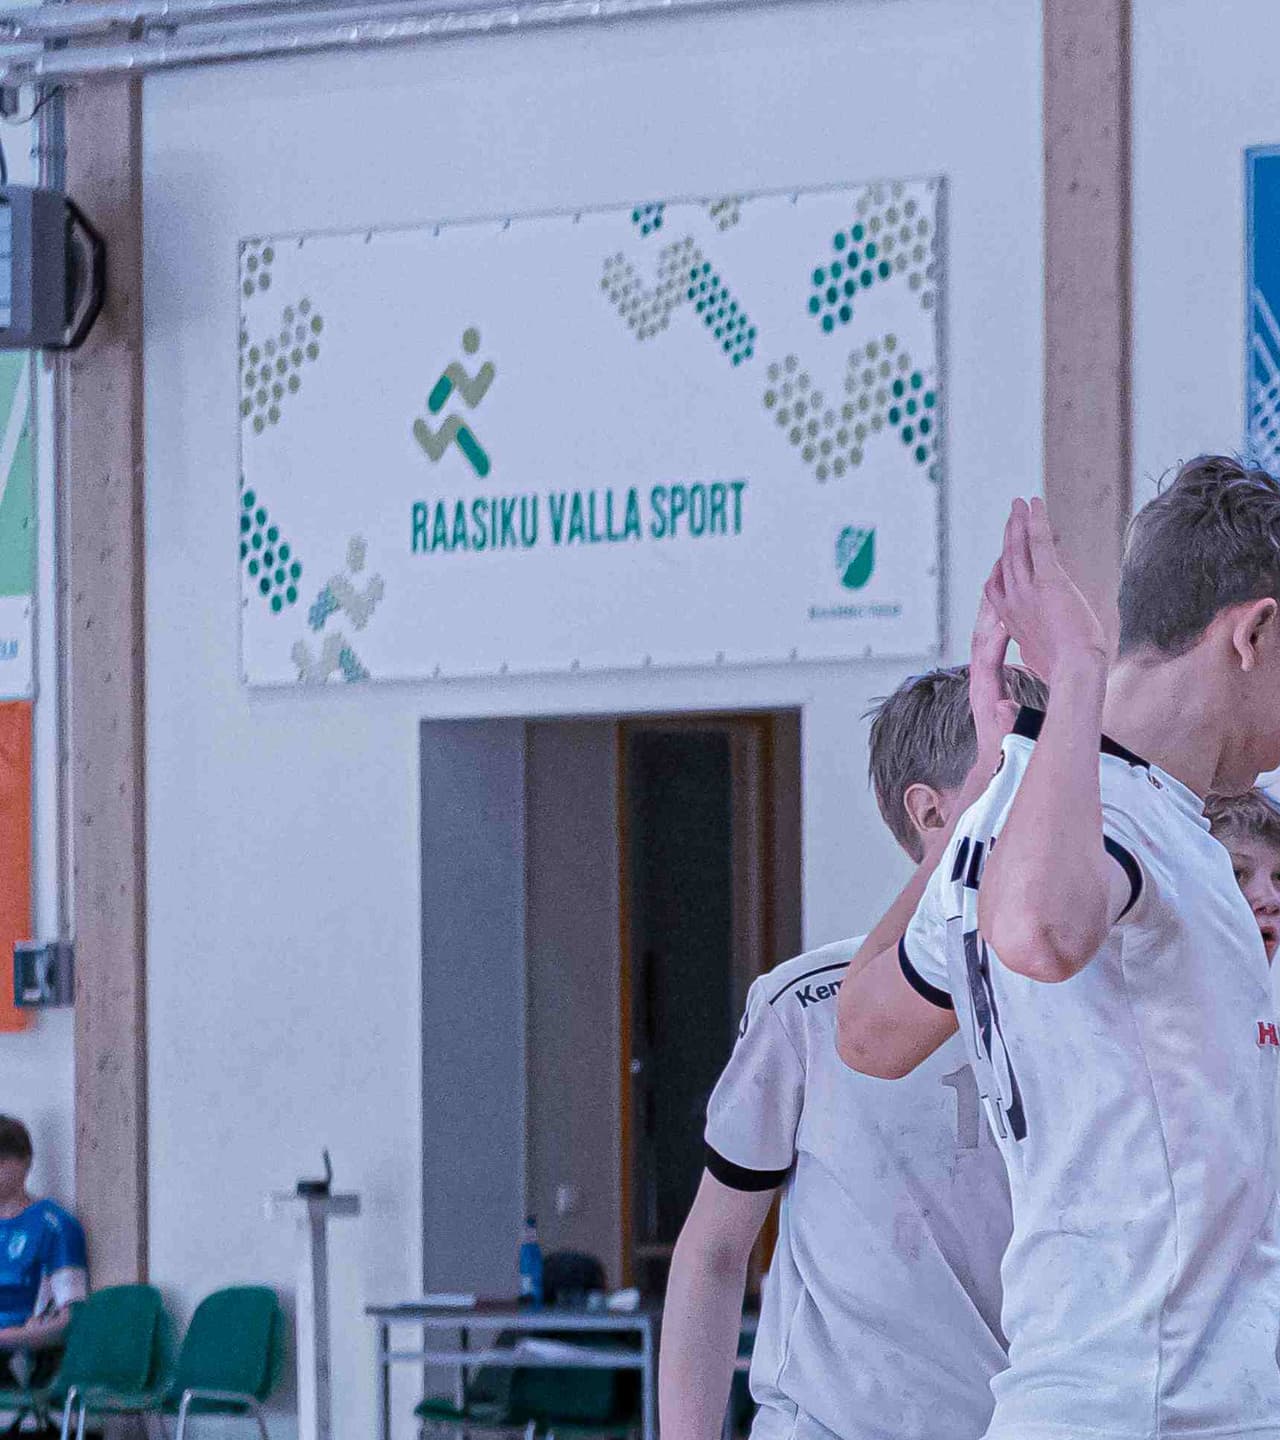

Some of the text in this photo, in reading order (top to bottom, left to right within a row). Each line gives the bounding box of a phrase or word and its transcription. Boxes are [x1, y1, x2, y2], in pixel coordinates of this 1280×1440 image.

[411, 480, 748, 555] RAASIKU VALLA SPORT
